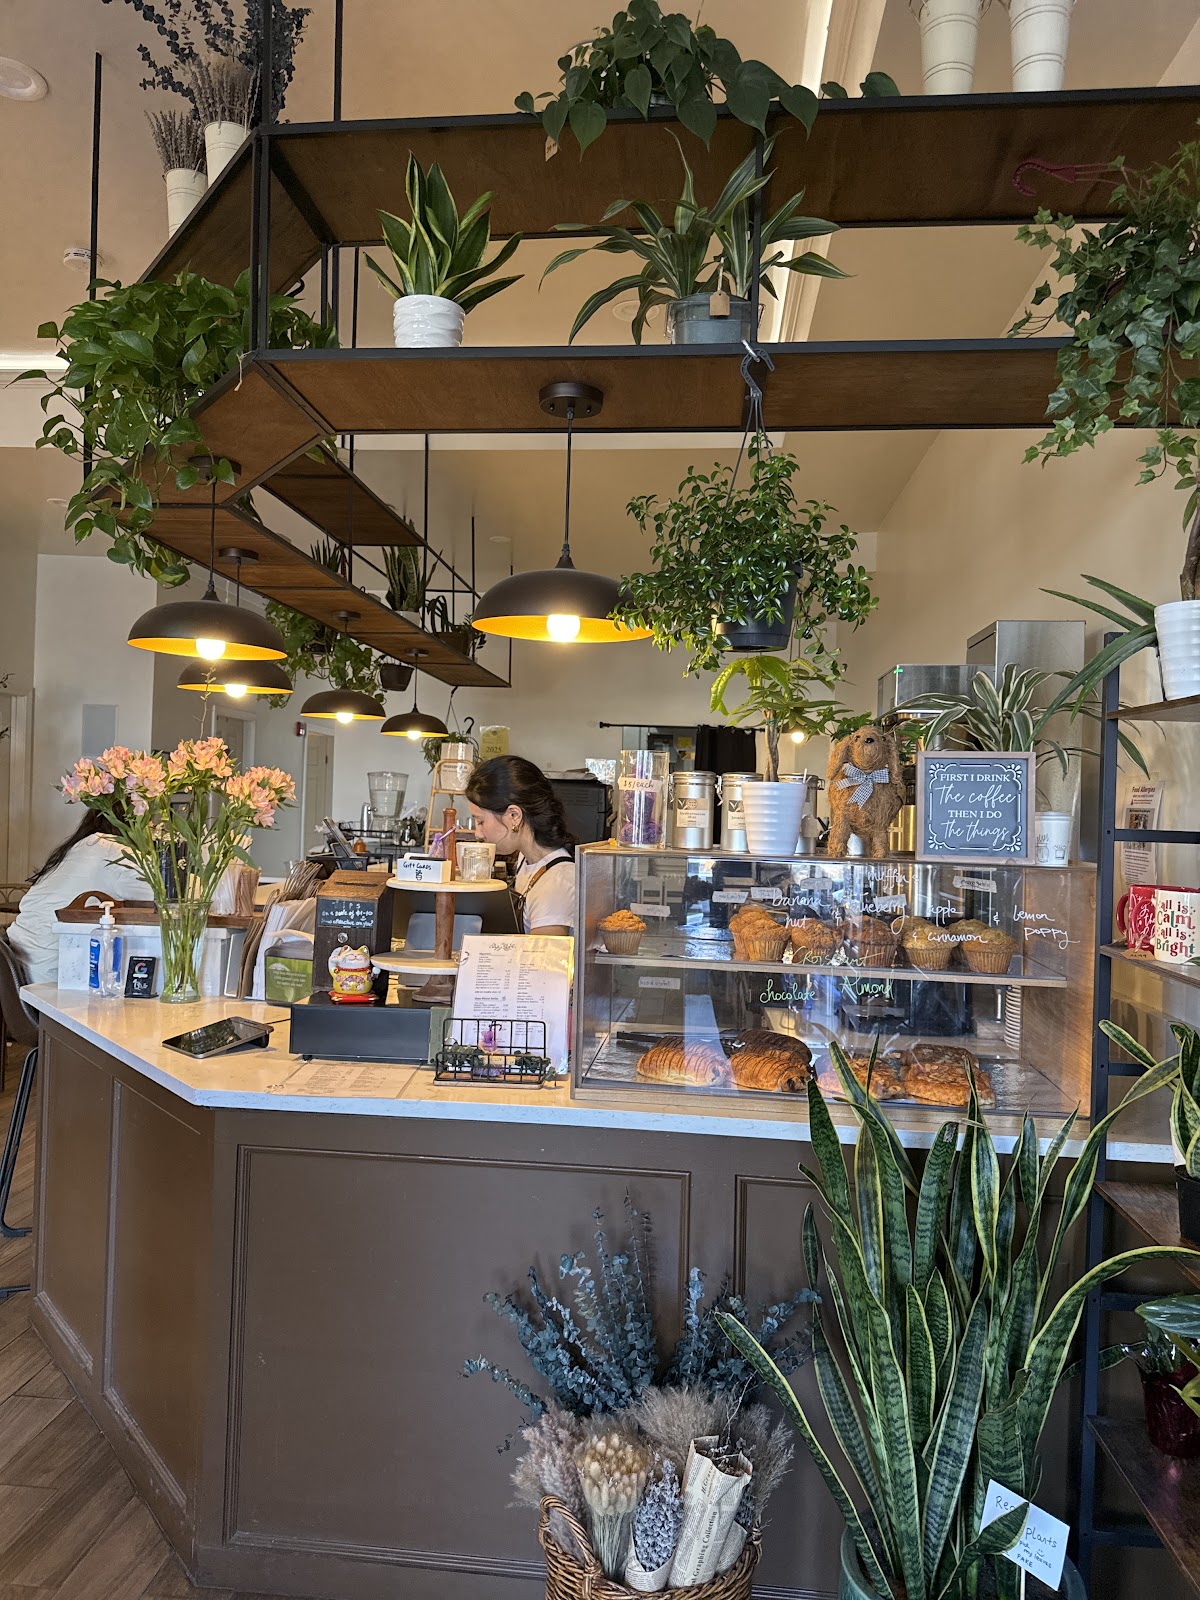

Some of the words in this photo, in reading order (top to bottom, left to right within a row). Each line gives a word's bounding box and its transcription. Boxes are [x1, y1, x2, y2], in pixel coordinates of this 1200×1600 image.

[486, 746, 502, 754] 2025
[623, 778, 655, 788] $5/each
[940, 773, 969, 782] FIRST
[970, 774, 975, 782] I
[976, 774, 1011, 782] DRINK
[935, 783, 965, 805] The
[968, 784, 1017, 809] coffee
[947, 810, 978, 819] THEN
[980, 810, 984, 818] I
[986, 810, 1002, 819] DO
[966, 819, 1010, 847] things
[1160, 900, 1172, 912] all
[1177, 901, 1189, 914] is
[785, 915, 811, 929] nut
[1156, 910, 1196, 930] Calm
[1024, 927, 1080, 950] poppy
[1159, 927, 1172, 939] all
[1175, 928, 1187, 941] is
[1156, 938, 1196, 958] Bright
[793, 946, 884, 966] Croisant
[692, 1544, 709, 1577] Graphing
[702, 1511, 718, 1544] Collection
[1017, 1553, 1033, 1568] FAKE
